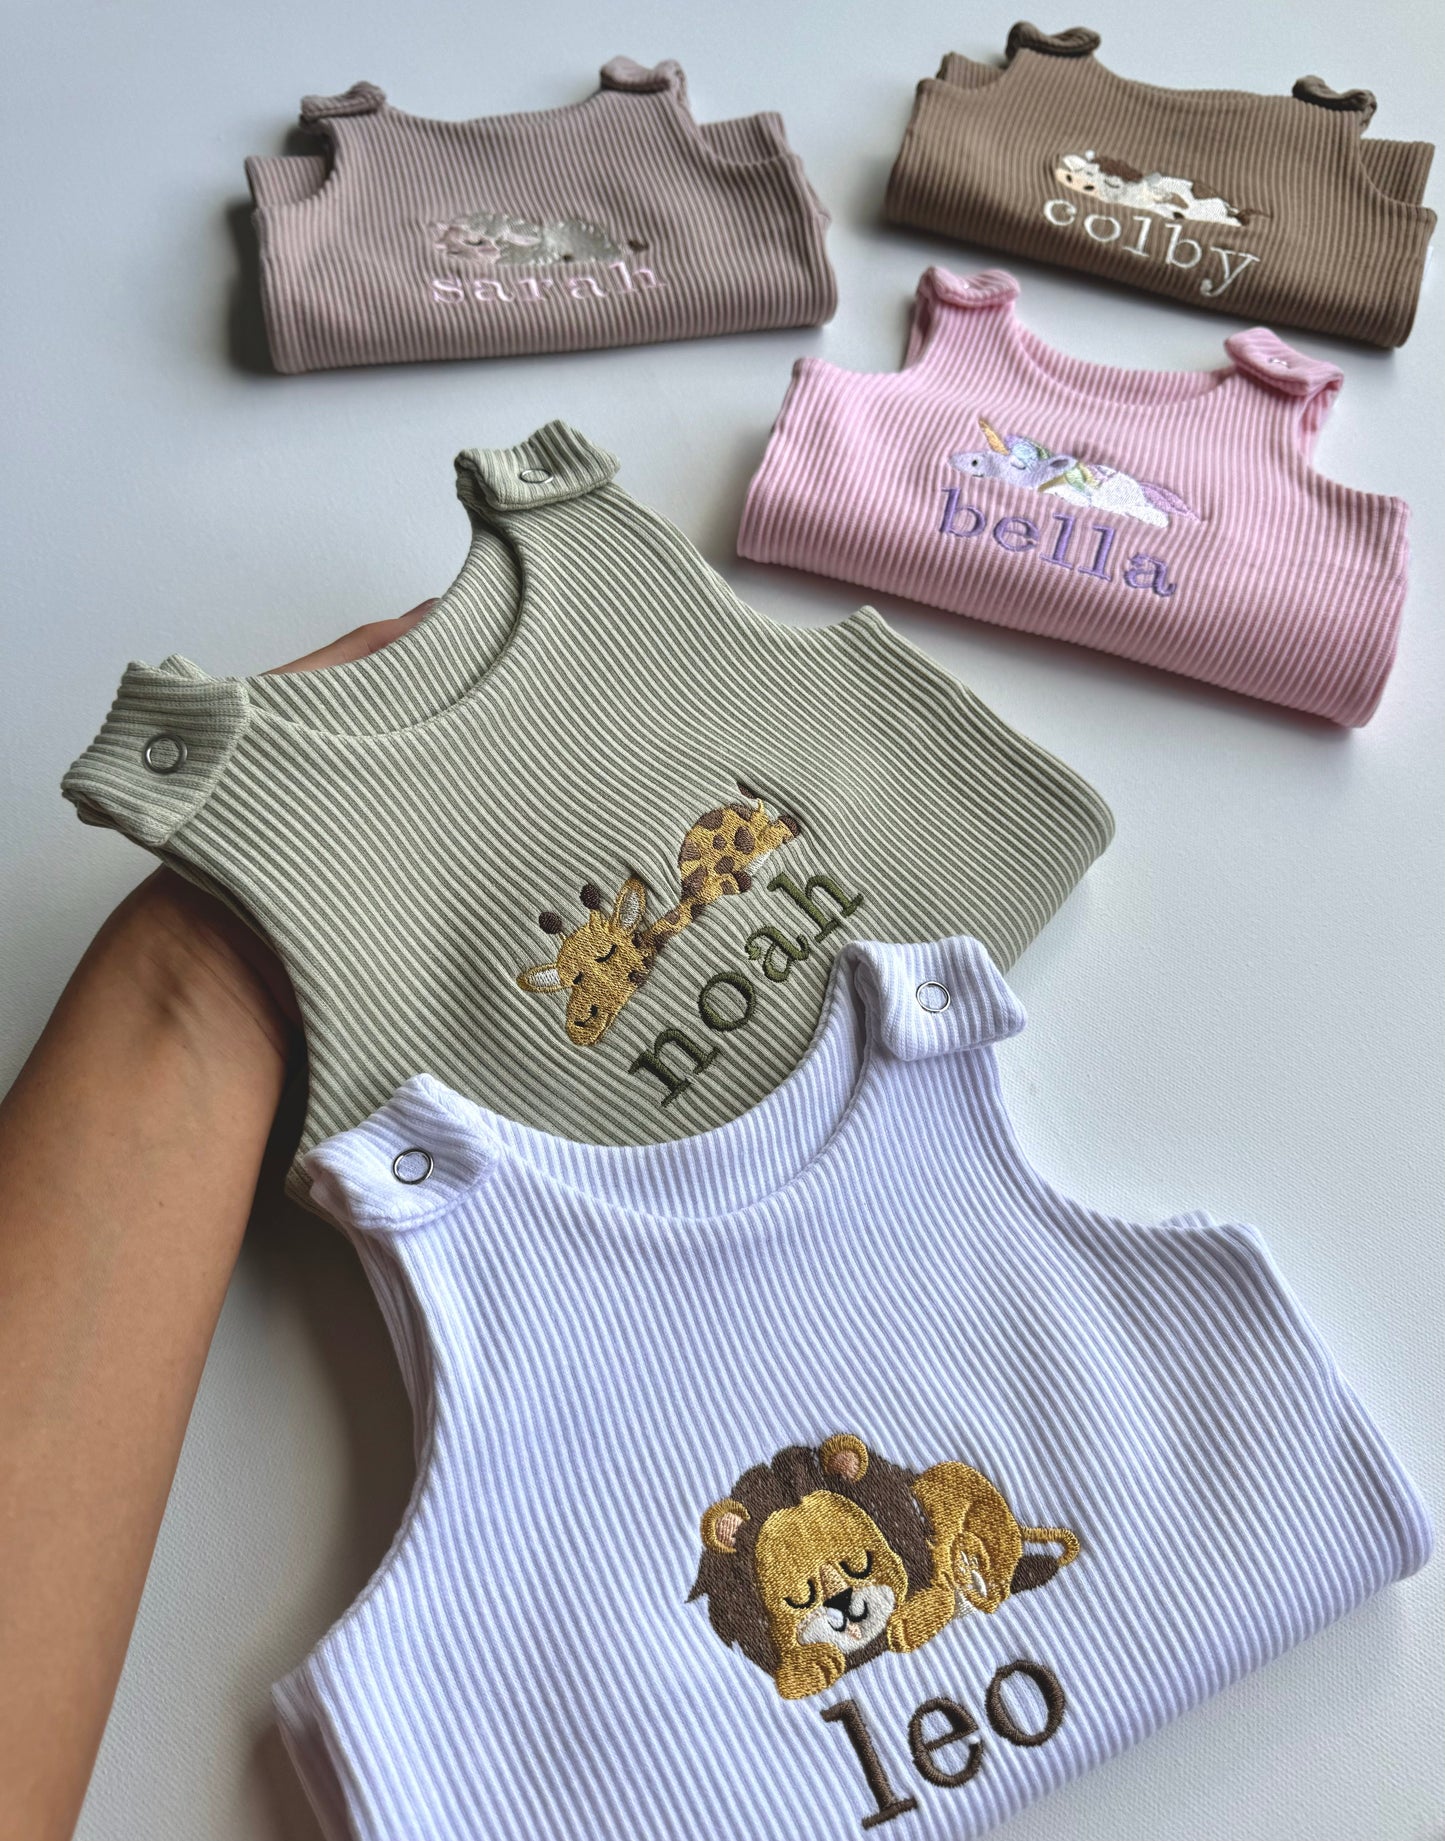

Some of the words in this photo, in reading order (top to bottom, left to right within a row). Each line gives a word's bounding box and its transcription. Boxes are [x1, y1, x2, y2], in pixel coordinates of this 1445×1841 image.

[431, 260, 668, 303] sarah
[1043, 199, 1261, 297] colby
[939, 487, 1178, 597] bella
[627, 871, 864, 1108] noah
[819, 1659, 1066, 1831] leo
